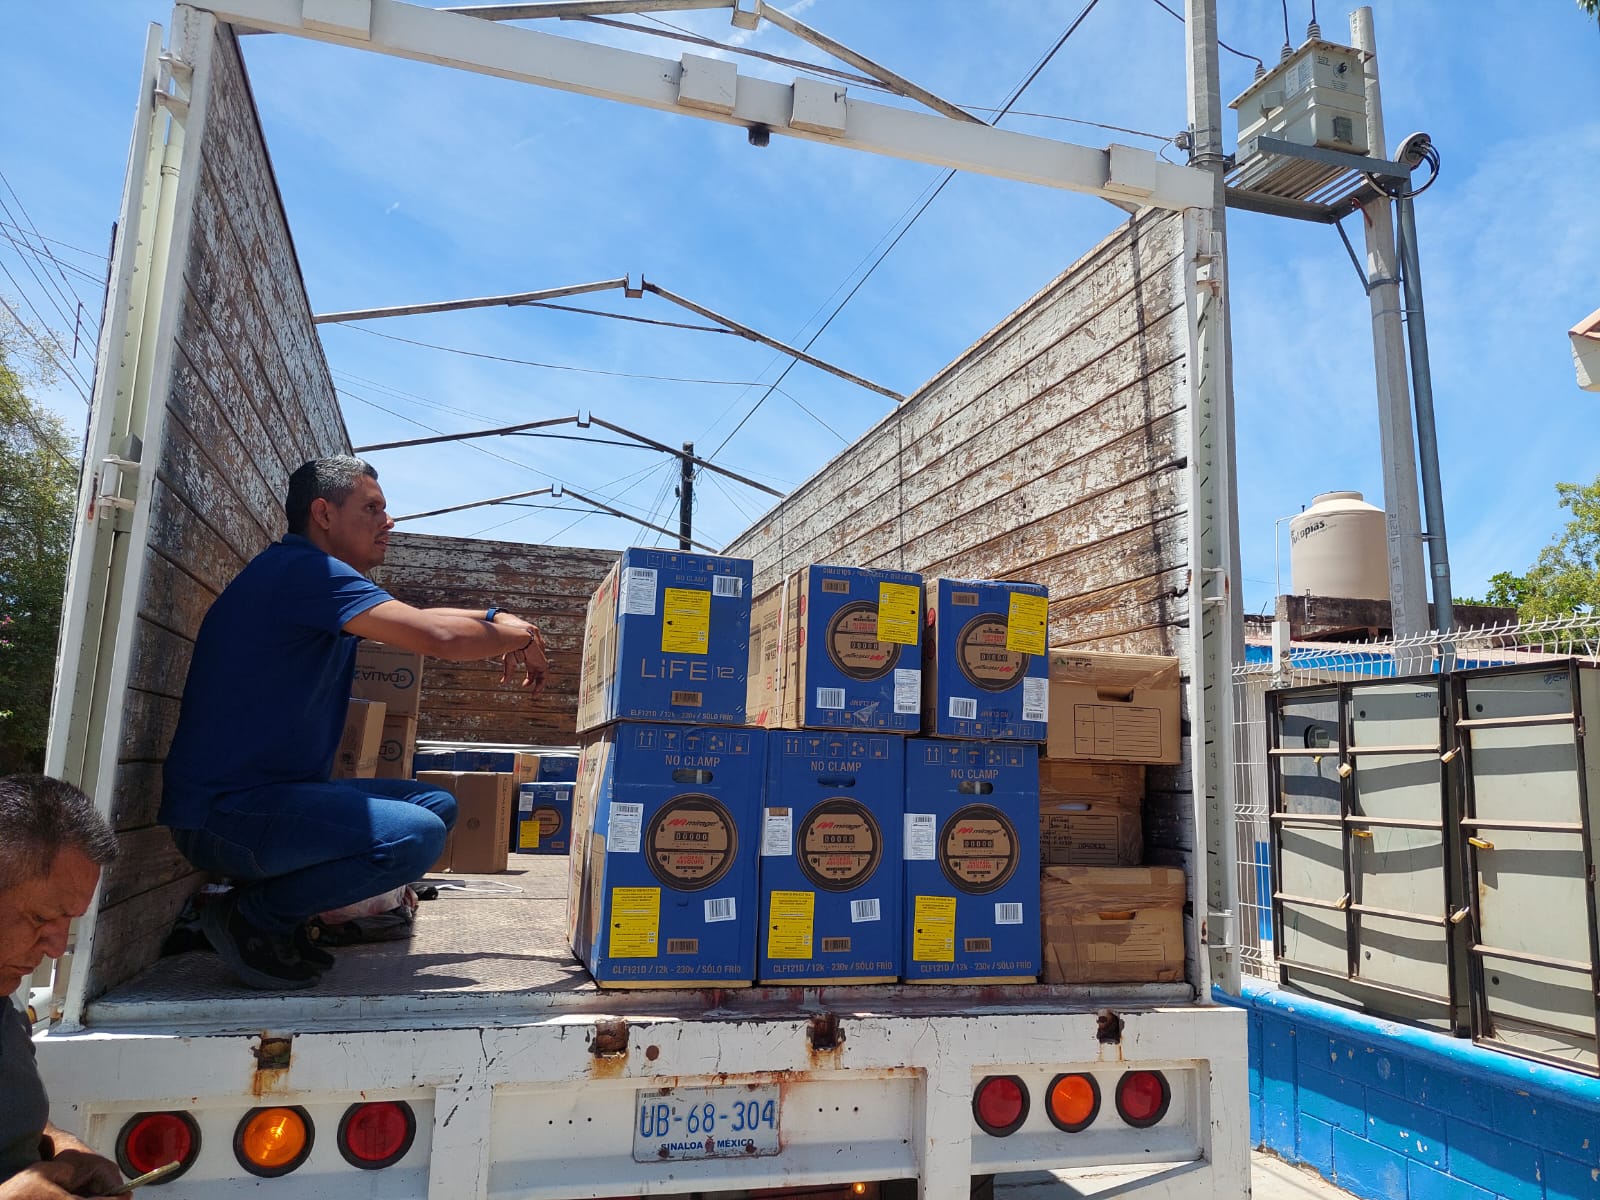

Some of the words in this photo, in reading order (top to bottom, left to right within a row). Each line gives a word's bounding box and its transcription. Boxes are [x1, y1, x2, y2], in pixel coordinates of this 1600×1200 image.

[717, 666, 734, 679] 12
[665, 754, 680, 765] NO
[684, 755, 720, 768] CLAMP
[810, 761, 824, 771] NO
[828, 761, 862, 772] CLAMP
[950, 769, 964, 778] NO
[967, 769, 999, 779] CLAMP
[702, 962, 721, 973] SÓLO
[724, 963, 741, 973] FRÍO
[855, 960, 874, 971] SÓLO
[876, 960, 893, 970] FRÍO
[996, 960, 1014, 970] SÓLO
[1016, 959, 1032, 969] FRÍO
[640, 1100, 775, 1137] UB-68-304
[660, 1141, 703, 1151] SINALOA
[717, 1138, 754, 1149] MÉXICO
